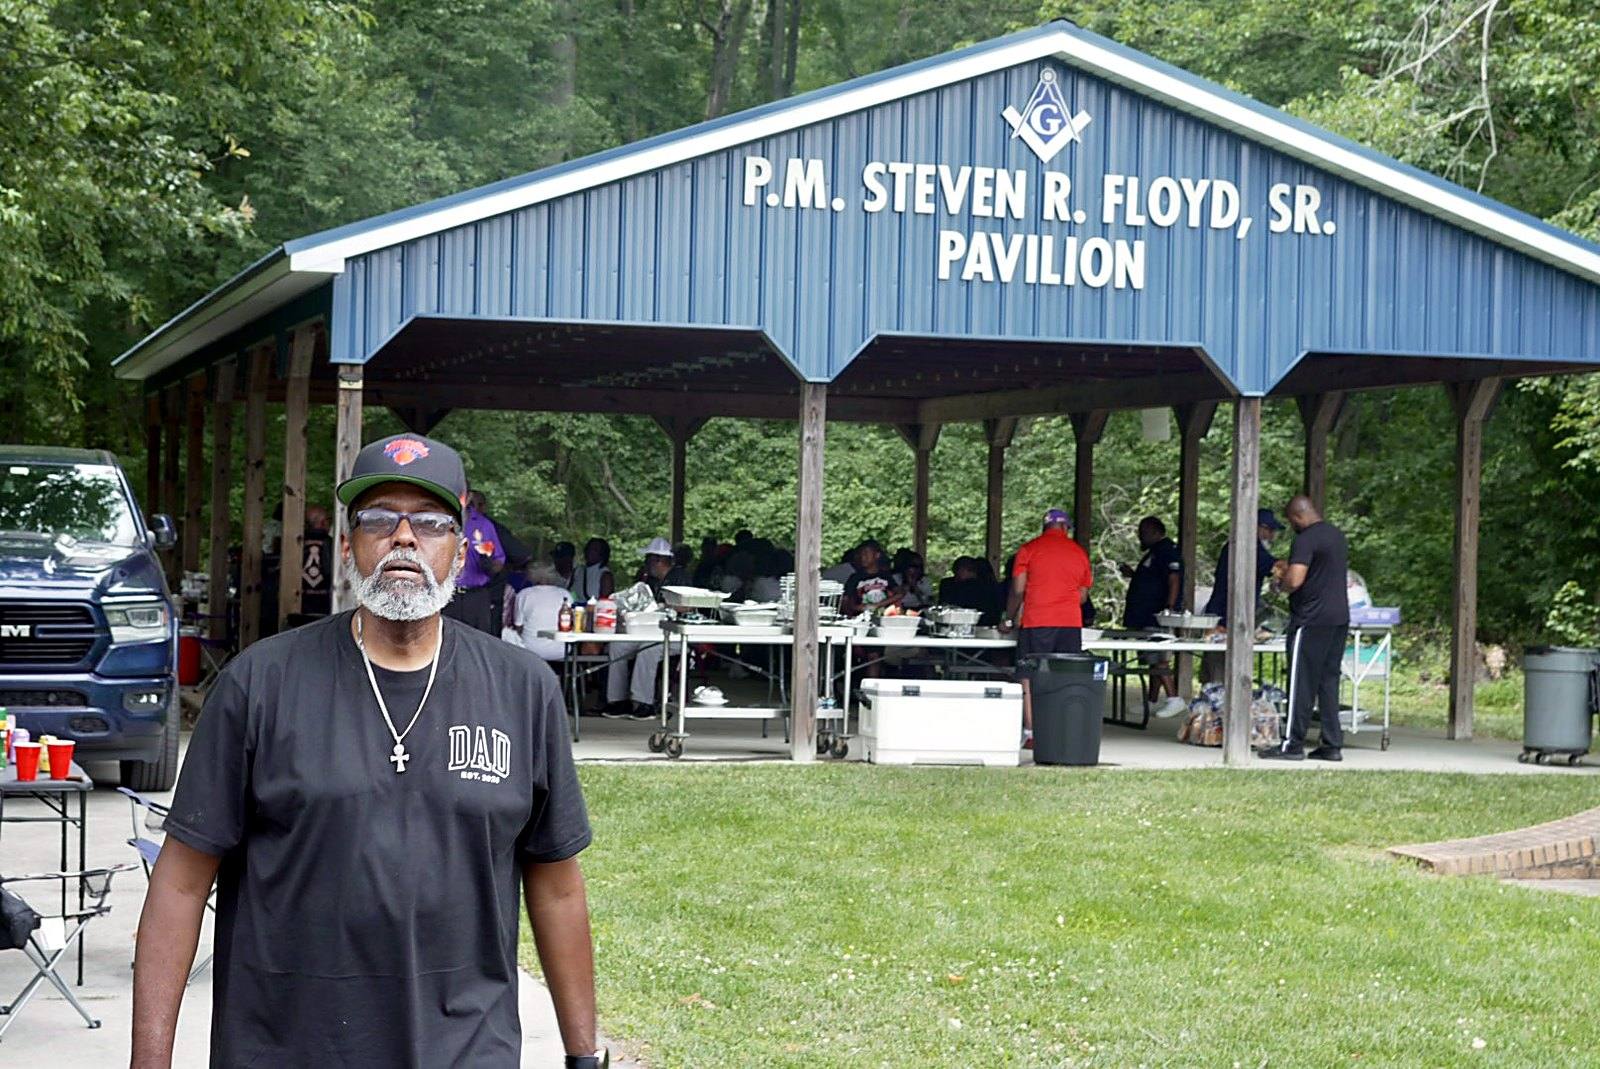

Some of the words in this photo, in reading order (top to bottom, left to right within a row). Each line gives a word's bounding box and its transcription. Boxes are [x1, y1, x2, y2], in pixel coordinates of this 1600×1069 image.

[1030, 103, 1062, 136] G
[743, 155, 846, 212] P.M.
[863, 161, 1027, 219] STEVEN
[1043, 170, 1087, 225] R.
[1102, 173, 1253, 240] FLOYD,
[1269, 183, 1336, 235] SR.
[938, 229, 1146, 289] PAVILION
[447, 724, 511, 779] DAD
